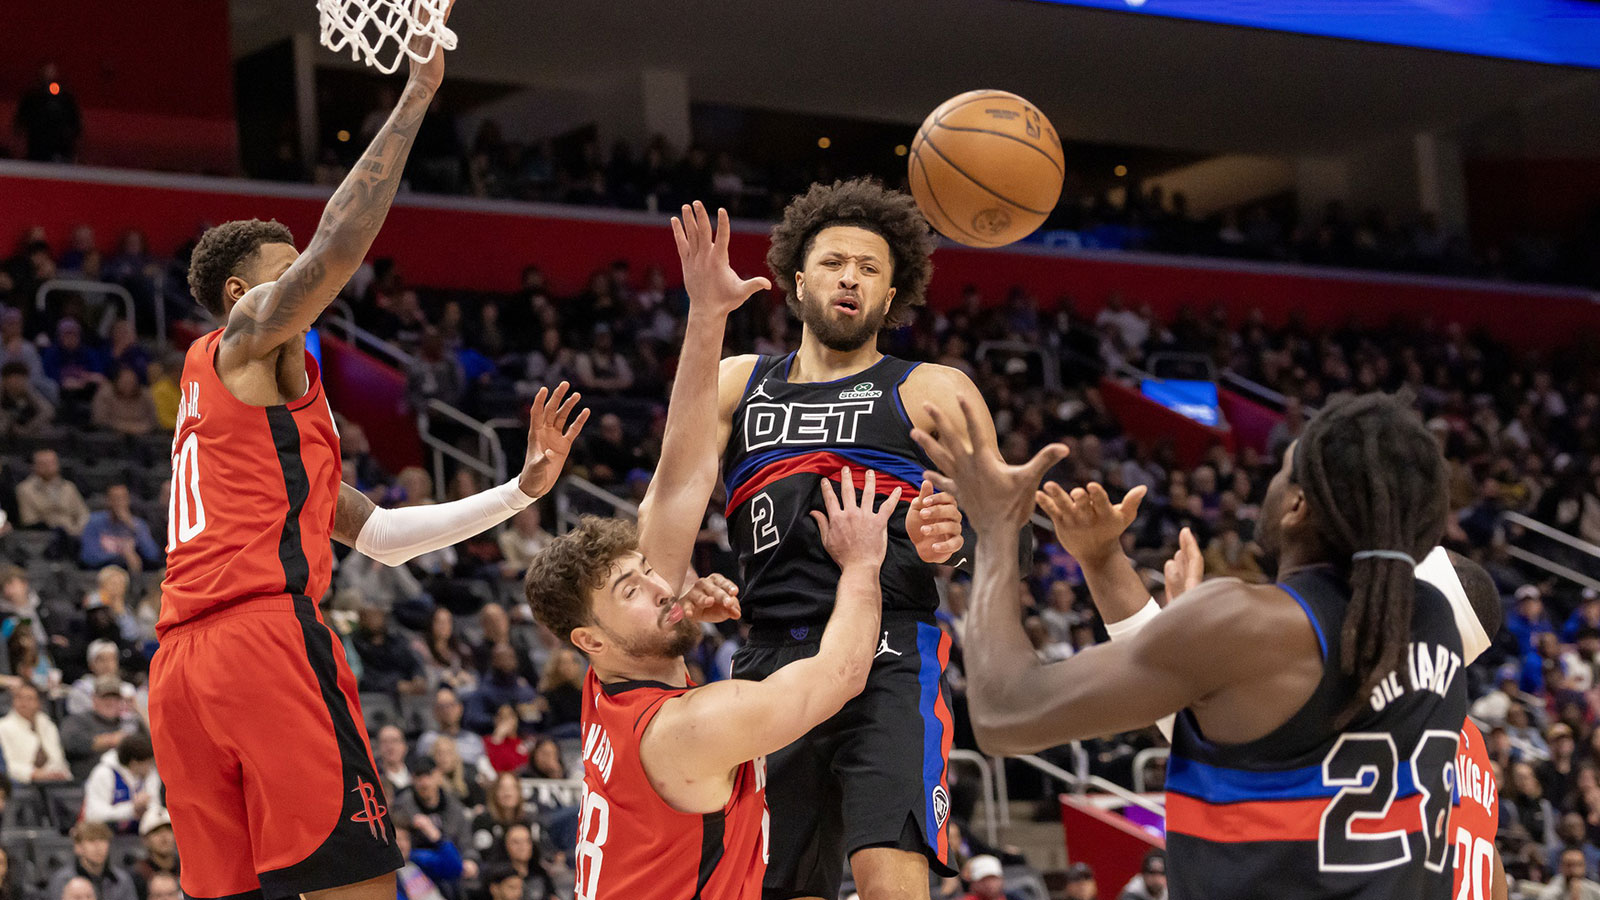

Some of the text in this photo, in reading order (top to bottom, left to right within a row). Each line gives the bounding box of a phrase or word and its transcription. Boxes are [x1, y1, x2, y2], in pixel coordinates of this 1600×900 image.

[839, 390, 881, 399] StockX
[745, 401, 874, 452] DET
[168, 431, 206, 553] 10
[751, 492, 780, 554] 2
[1318, 729, 1461, 873] 28
